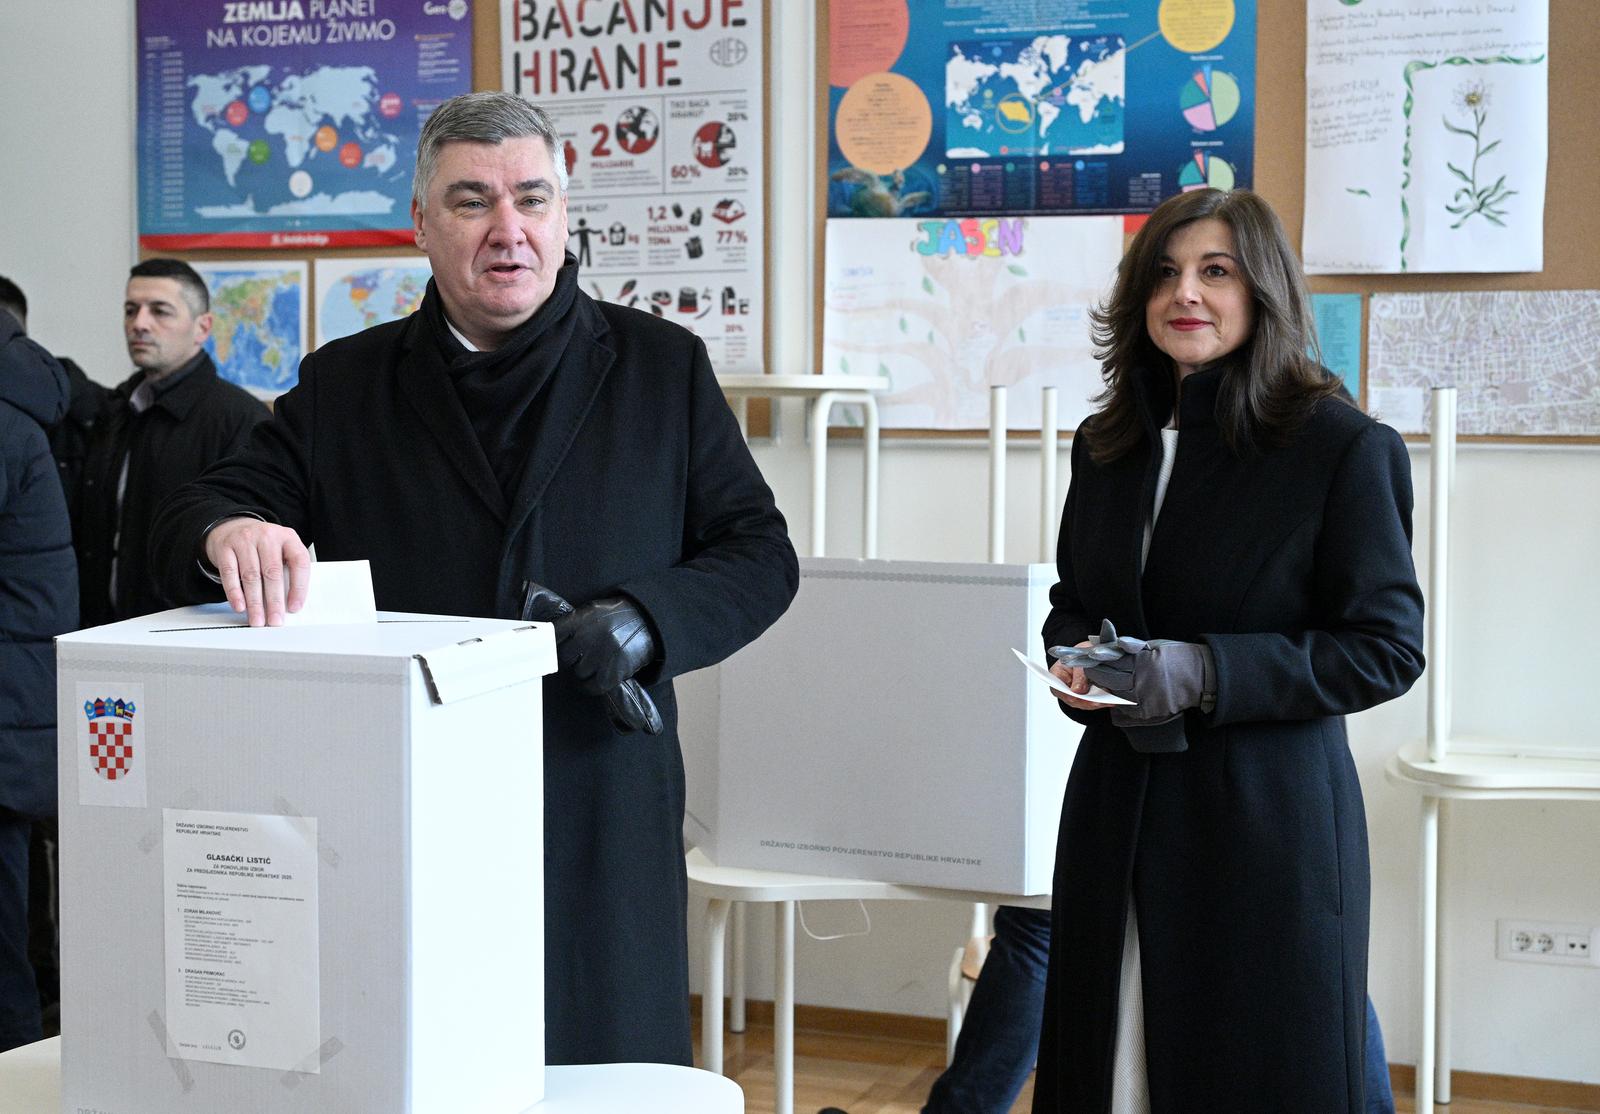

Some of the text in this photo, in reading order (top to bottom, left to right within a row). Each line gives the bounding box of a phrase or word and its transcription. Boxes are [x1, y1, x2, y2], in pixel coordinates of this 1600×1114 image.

[223, 0, 375, 23] ZEMLJA PLANET
[513, 0, 747, 42] BACANJE
[206, 26, 238, 48] NA
[242, 24, 321, 47] KOJEMU
[326, 18, 396, 44] ŽIVIMO
[513, 40, 682, 95] HRANE
[591, 123, 612, 157] 2
[647, 205, 667, 222] 1,2
[914, 217, 1025, 257] JASEN
[206, 853, 272, 865] GLASAČKI LISTIĆ
[760, 840, 982, 866] DRŽAVNO IZBORNO POVJERENSTVO REPUBLIKE HRVATSKE
